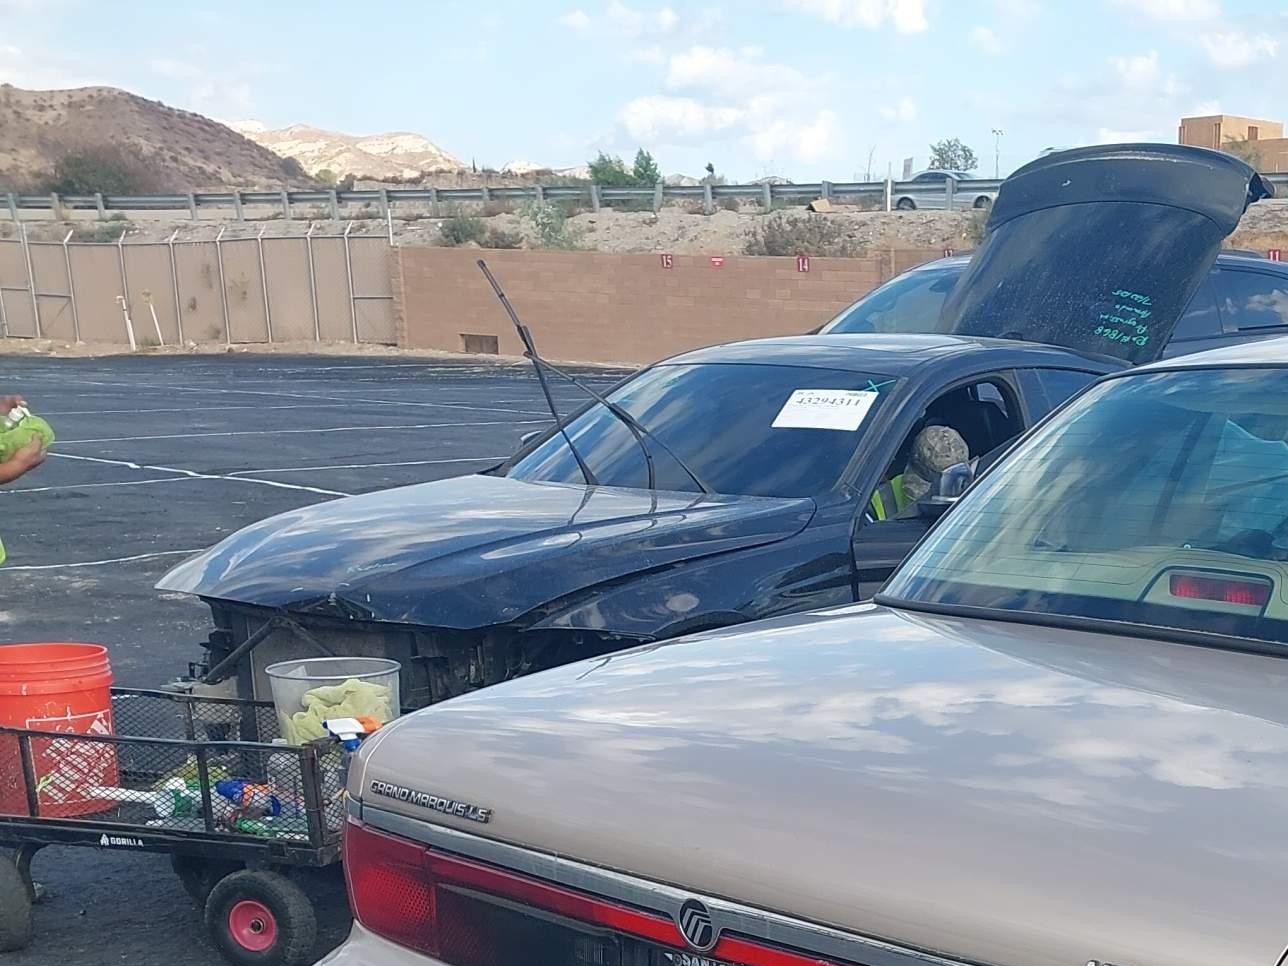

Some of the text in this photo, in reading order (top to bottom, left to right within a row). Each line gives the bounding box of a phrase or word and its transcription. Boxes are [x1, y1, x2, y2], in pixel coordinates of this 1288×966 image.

[662, 255, 672, 268] 15
[799, 258, 809, 271] 14
[370, 779, 490, 824] GRAND MARQUIS LS
[110, 837, 144, 847] GORILLA
